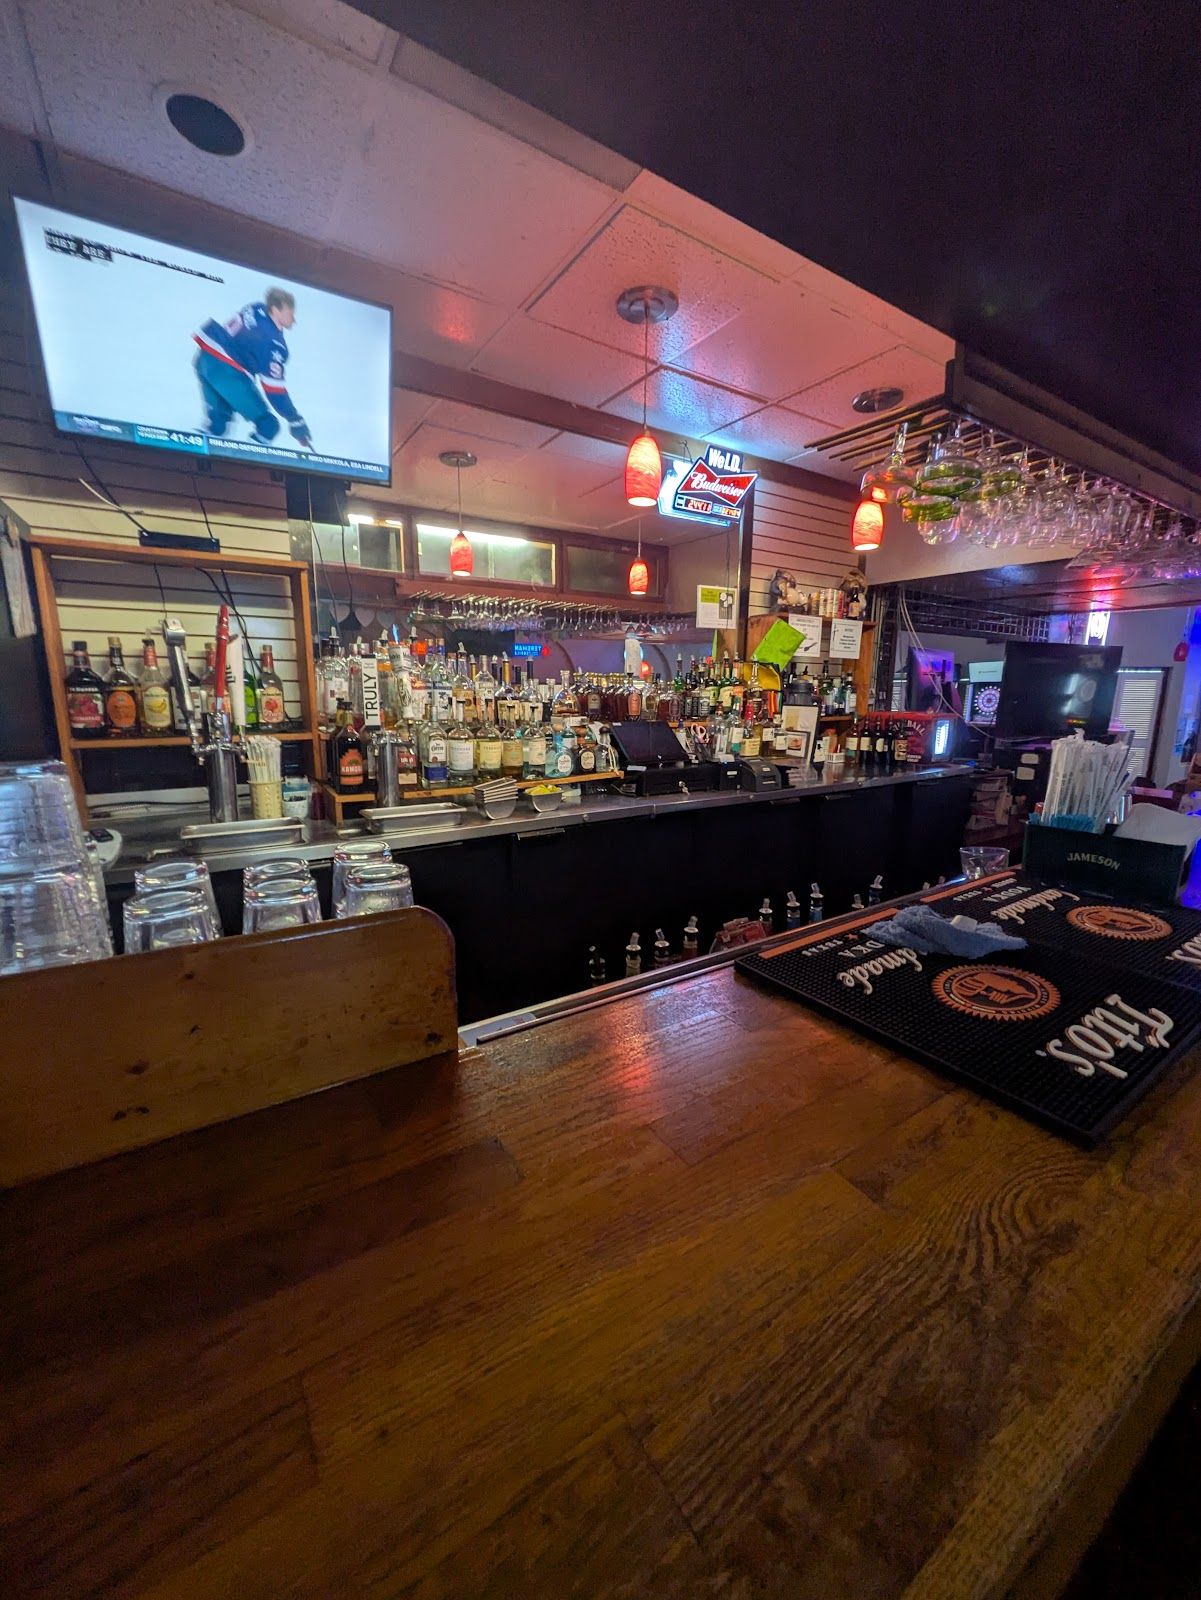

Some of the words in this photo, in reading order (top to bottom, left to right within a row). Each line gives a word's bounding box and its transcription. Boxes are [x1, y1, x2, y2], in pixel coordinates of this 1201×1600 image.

[208, 438, 238, 449] FINLAND
[691, 472, 744, 497] Budweiser
[364, 673, 379, 720] TRULY
[1067, 852, 1120, 870] JAMESON
[801, 939, 843, 957] TEXAS
[838, 940, 885, 958] DKA
[837, 947, 923, 995] dmade
[1046, 994, 1174, 1079] Tito's
